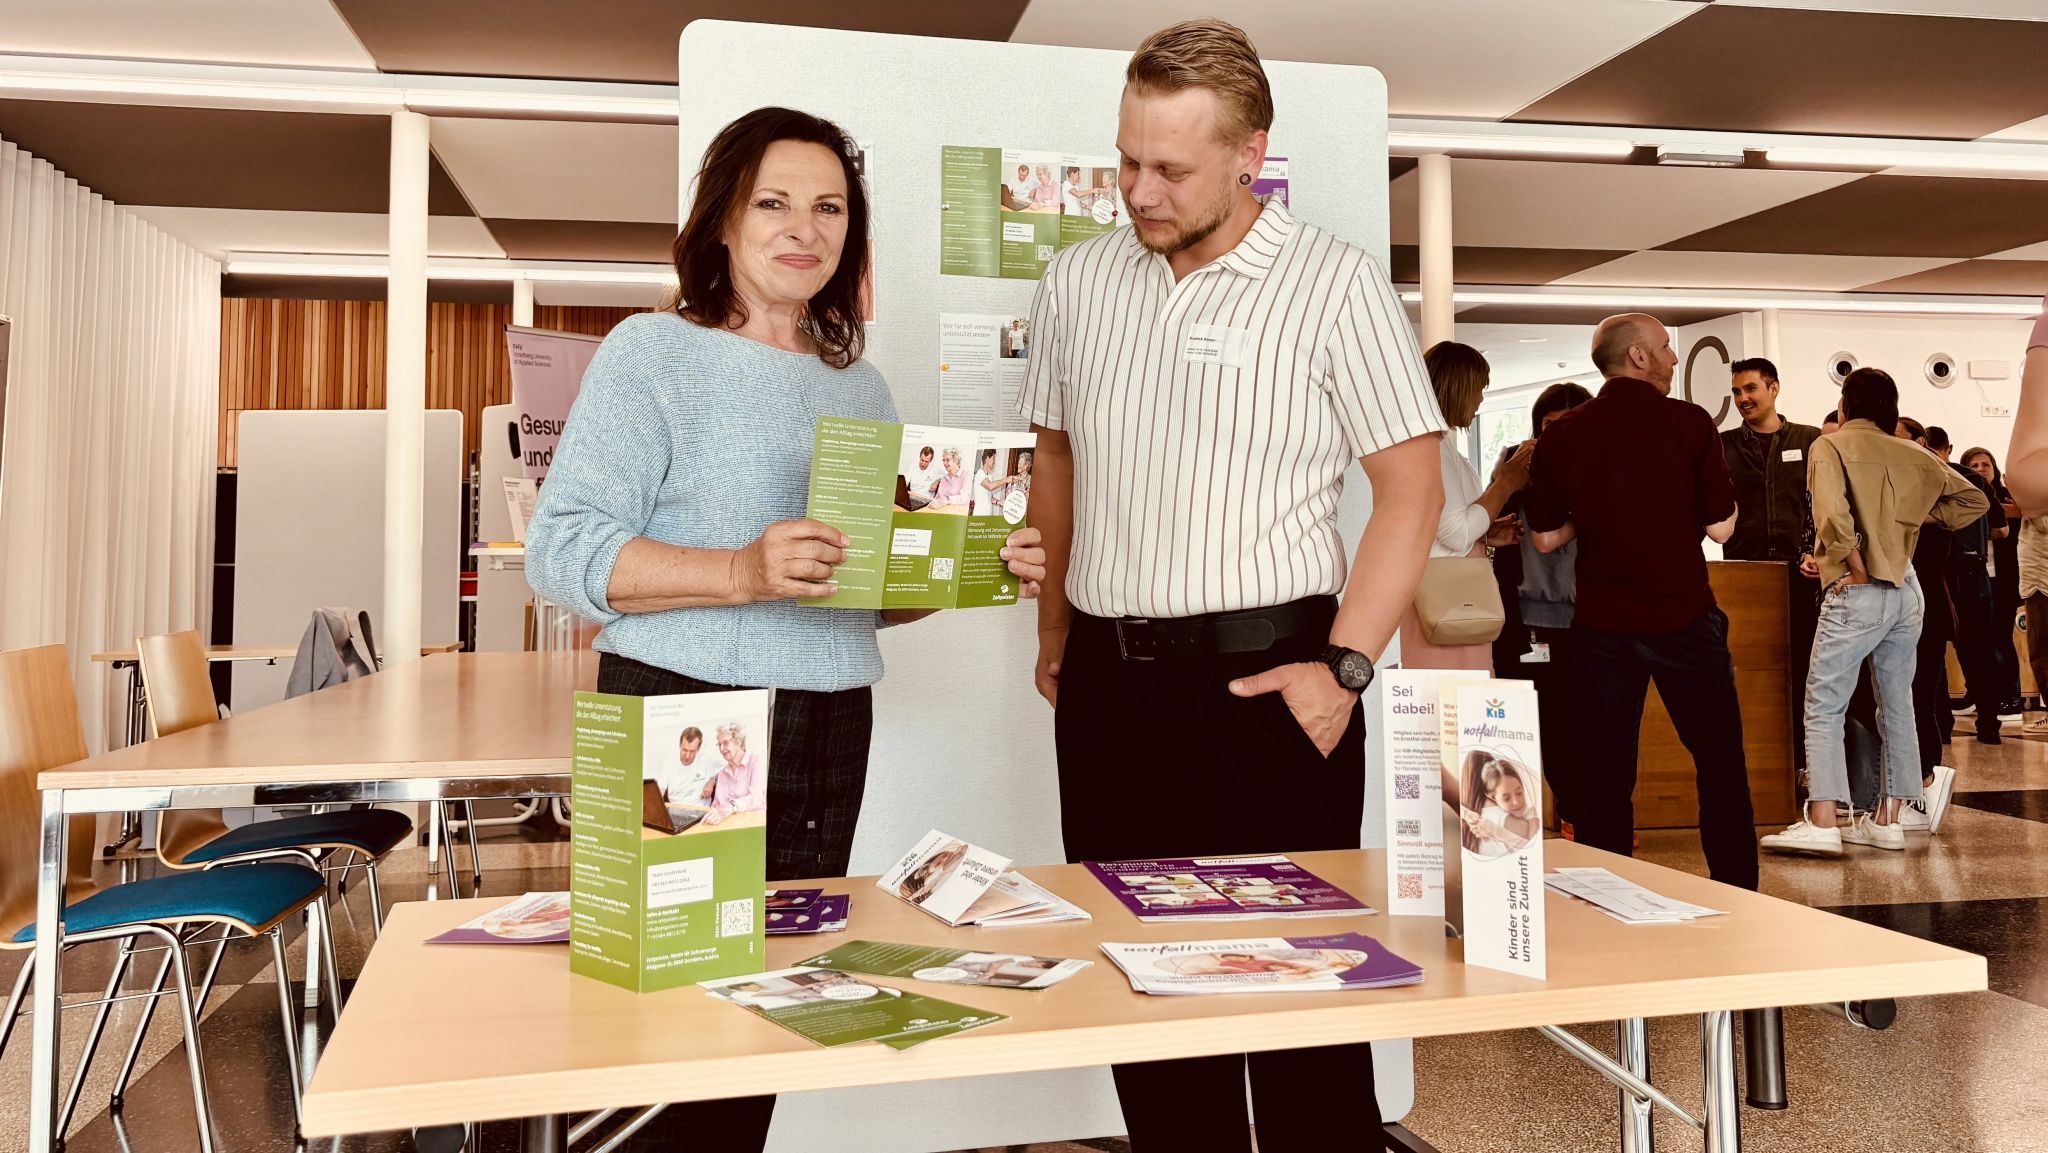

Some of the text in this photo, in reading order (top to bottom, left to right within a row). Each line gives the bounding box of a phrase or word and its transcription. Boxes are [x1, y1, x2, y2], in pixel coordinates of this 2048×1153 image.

[1684, 336, 1731, 427] C
[524, 446, 553, 467] und
[1392, 685, 1413, 697] Sei
[1392, 703, 1435, 715] dabei!
[1486, 706, 1506, 719] KiB
[1464, 722, 1534, 743] notfallmama
[1518, 855, 1531, 963] unsere Zukunft
[1507, 880, 1518, 960] Kinder sind
[1124, 942, 1269, 955] notfallmama
